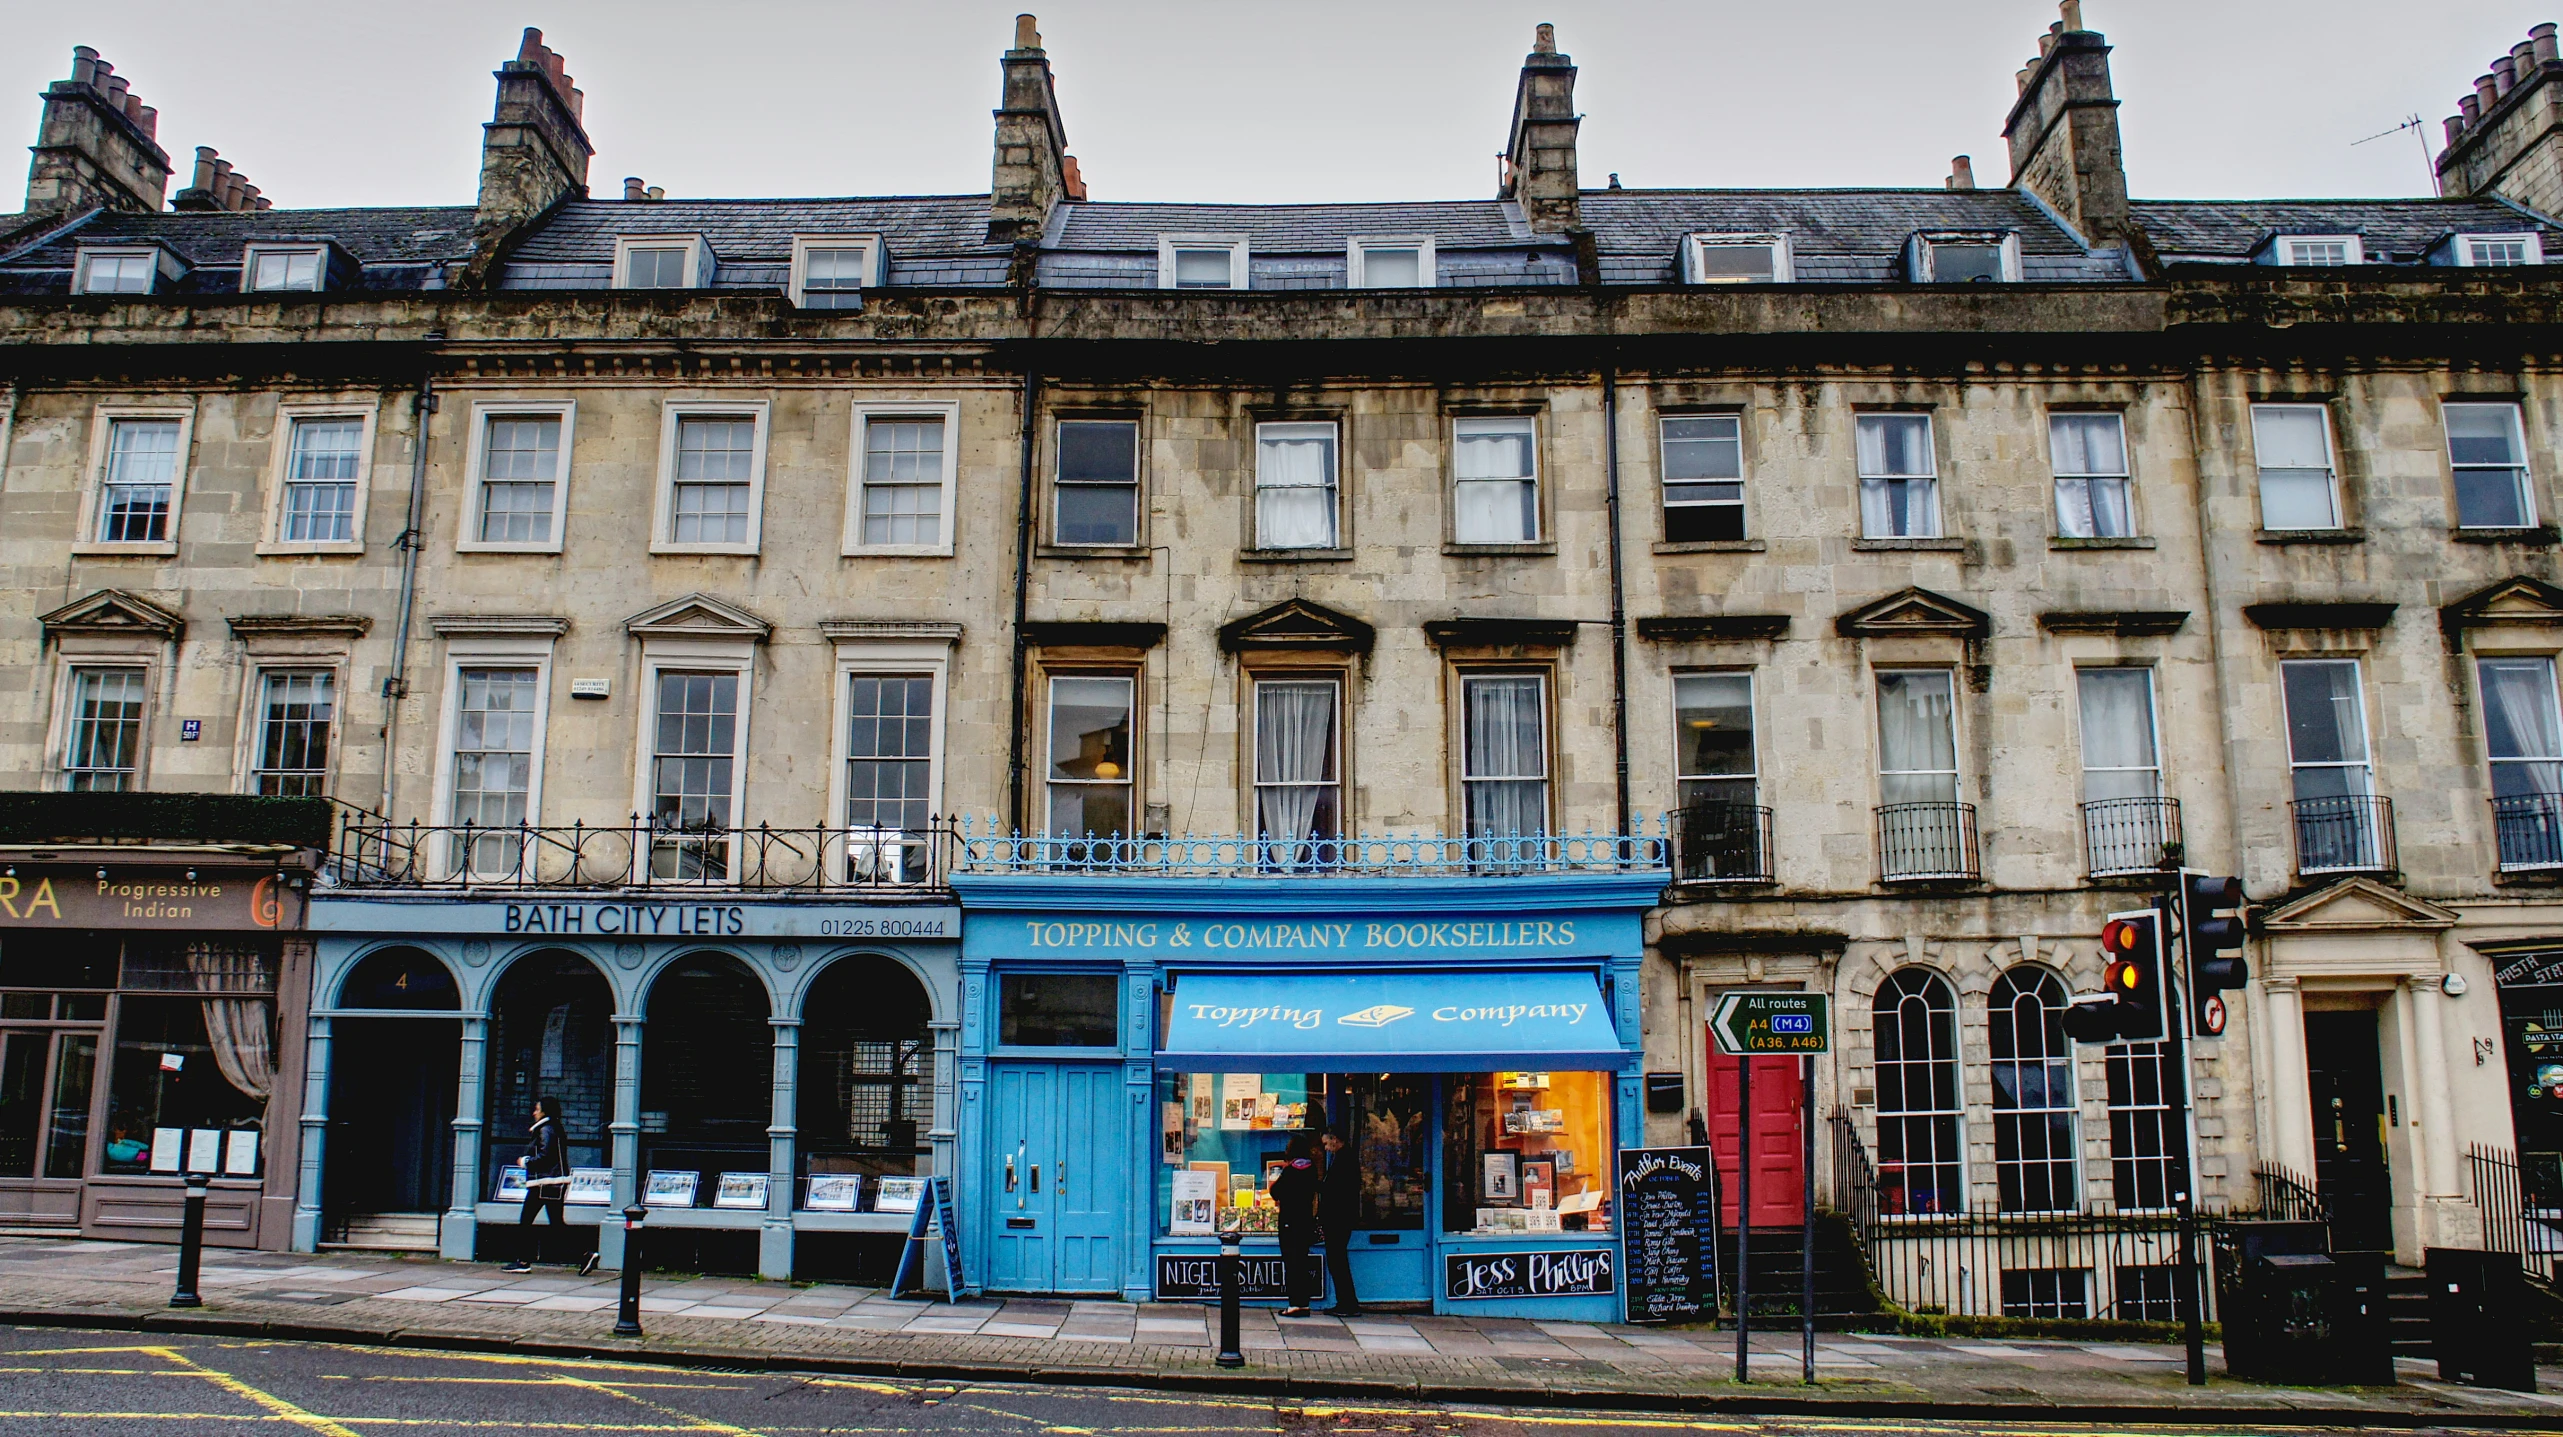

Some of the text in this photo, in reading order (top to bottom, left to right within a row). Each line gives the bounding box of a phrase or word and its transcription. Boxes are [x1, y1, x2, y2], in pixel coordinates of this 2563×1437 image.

[186, 722, 197, 730] H
[0, 876, 62, 919] RA
[98, 880, 222, 900] Progressive
[124, 901, 192, 918] Indian
[505, 905, 743, 935] BATH CITY LETS
[820, 919, 944, 936] 01225 800444
[1026, 921, 1576, 948] TOPPING & COMPANY BOOKSELLERS
[2495, 954, 2540, 986] PASTA
[395, 972, 408, 990] 4
[1748, 998, 1807, 1009] All routes
[1188, 1004, 1322, 1029] Topping
[1432, 1003, 1588, 1024] Company
[1750, 1018, 1809, 1030] A4 (M4)
[1791, 1036, 1824, 1048] A46)
[2525, 1034, 2550, 1042] PASTA
[1624, 1153, 1702, 1191] Author Events
[1166, 1261, 1222, 1286] NIGEL
[1453, 1252, 1610, 1297] Jess Phillips
[1476, 1287, 1493, 1295] SAT
